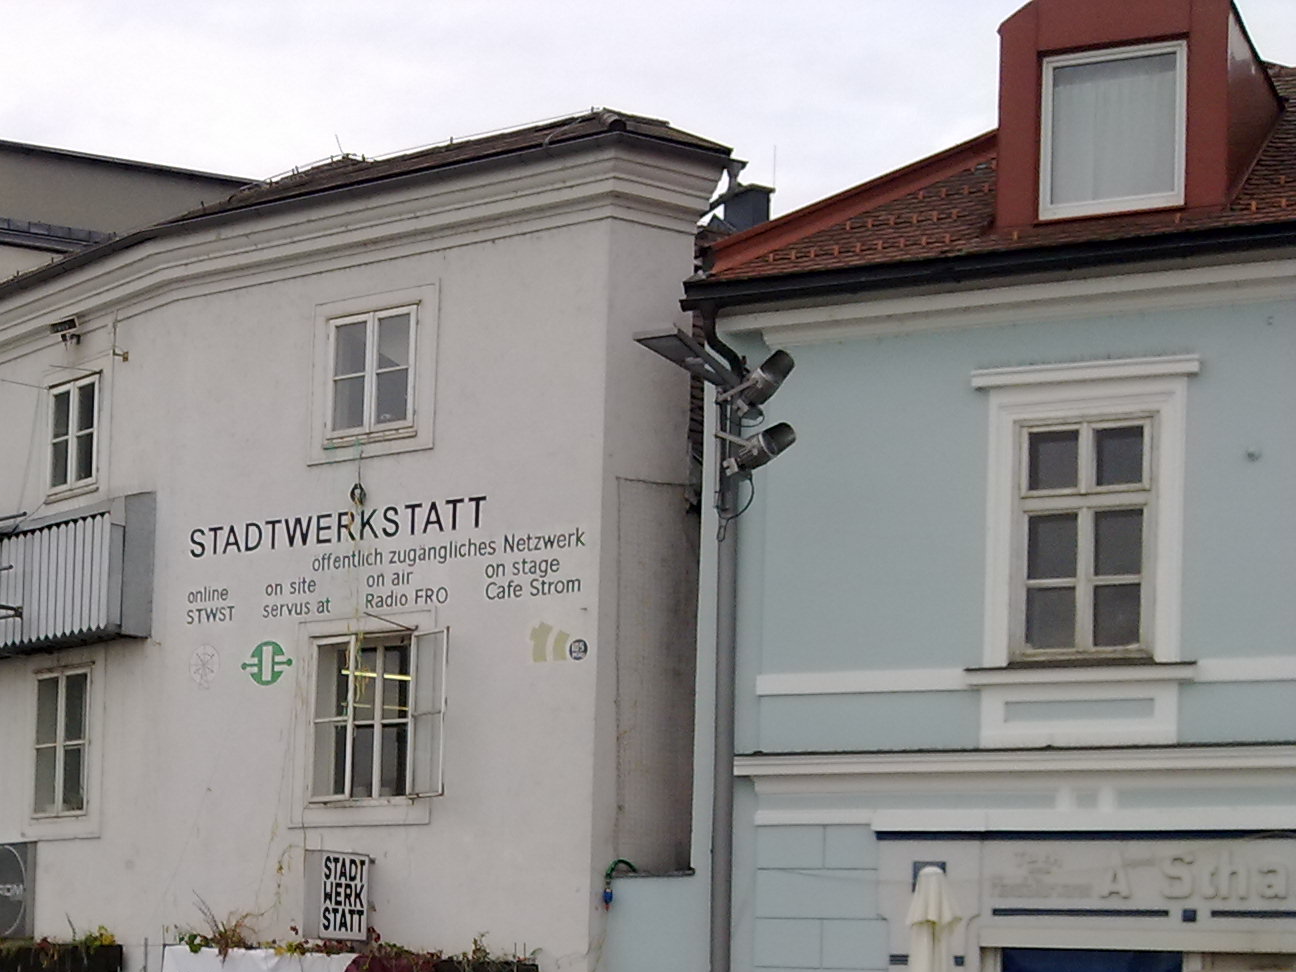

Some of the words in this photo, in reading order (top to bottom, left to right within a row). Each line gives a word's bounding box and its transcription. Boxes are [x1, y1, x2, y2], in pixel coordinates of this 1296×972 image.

[190, 496, 487, 558] STADTWERKSTATT
[389, 538, 496, 568] zugängliches
[503, 527, 586, 554] Netzwerk
[366, 572, 385, 588] on
[391, 569, 414, 586] air
[485, 561, 506, 579] on
[512, 558, 560, 579] stage
[187, 586, 229, 604] online
[265, 583, 283, 597] on
[289, 576, 317, 595] site
[365, 590, 408, 609] Radio
[414, 586, 449, 605] FRO
[485, 581, 523, 601] Cafe
[530, 577, 582, 598] Strom
[186, 605, 235, 625] STWST
[263, 599, 311, 618] servus
[316, 597, 331, 614] at
[323, 855, 366, 883] STADT
[323, 881, 365, 908] WERK
[322, 906, 365, 933] STATT
